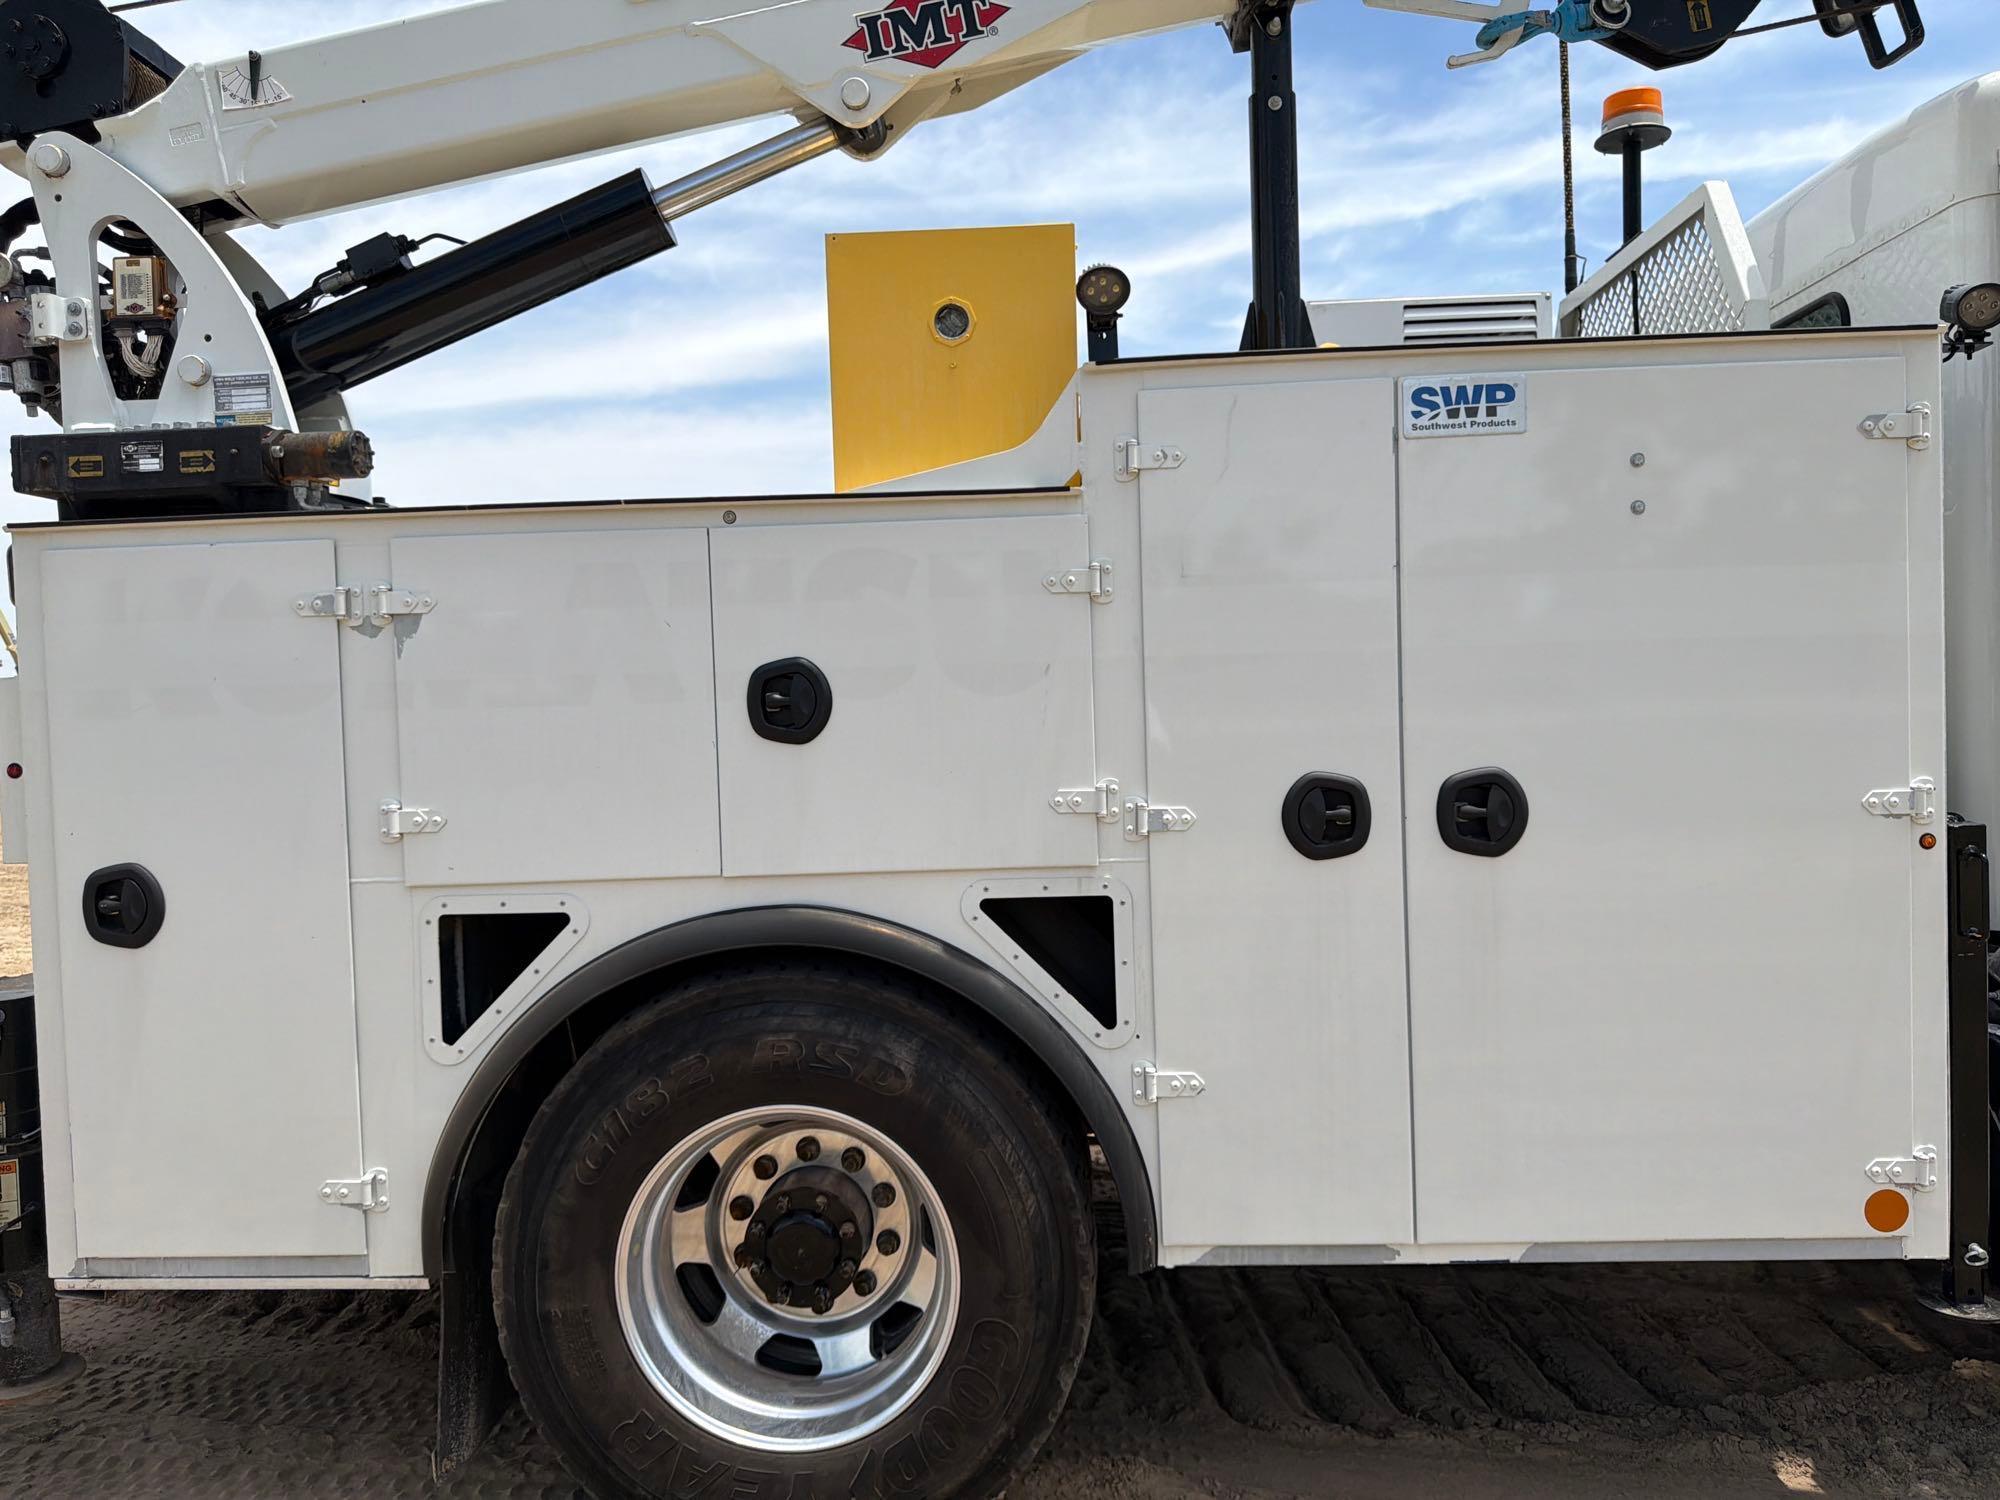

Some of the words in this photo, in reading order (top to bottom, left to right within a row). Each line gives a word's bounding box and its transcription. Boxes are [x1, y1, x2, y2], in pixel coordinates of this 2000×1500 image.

[1410, 383, 1516, 421] SWP
[1411, 420, 1467, 432] Southwest
[1470, 418, 1517, 429] Products
[752, 1034, 913, 1098] RSD
